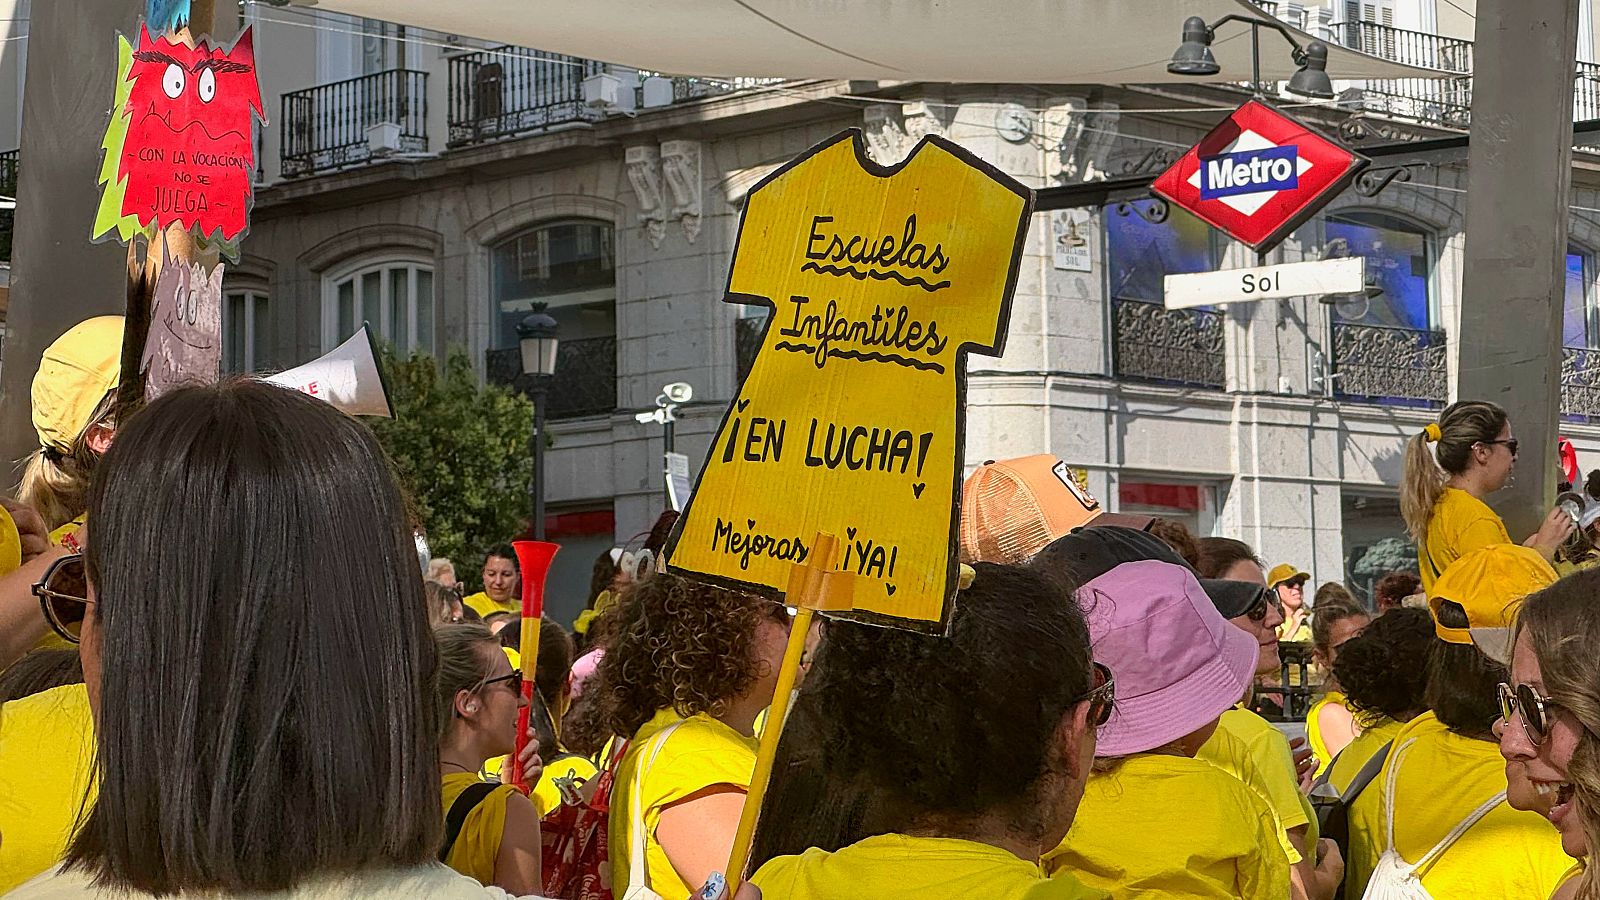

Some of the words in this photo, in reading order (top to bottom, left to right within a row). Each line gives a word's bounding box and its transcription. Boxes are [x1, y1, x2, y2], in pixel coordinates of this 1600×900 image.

[138, 147, 164, 161] CON
[173, 150, 187, 165] LA
[174, 171, 192, 183] NO
[196, 174, 210, 186] SE
[1208, 157, 1292, 190] Metro
[150, 186, 208, 213] JUEGA
[805, 213, 950, 275] Escuelas
[1241, 271, 1280, 294] Sol
[779, 295, 948, 369] Infantiles
[722, 398, 787, 463] ¡EN
[804, 417, 934, 500] LUCHA!
[711, 517, 809, 570] Mejoras
